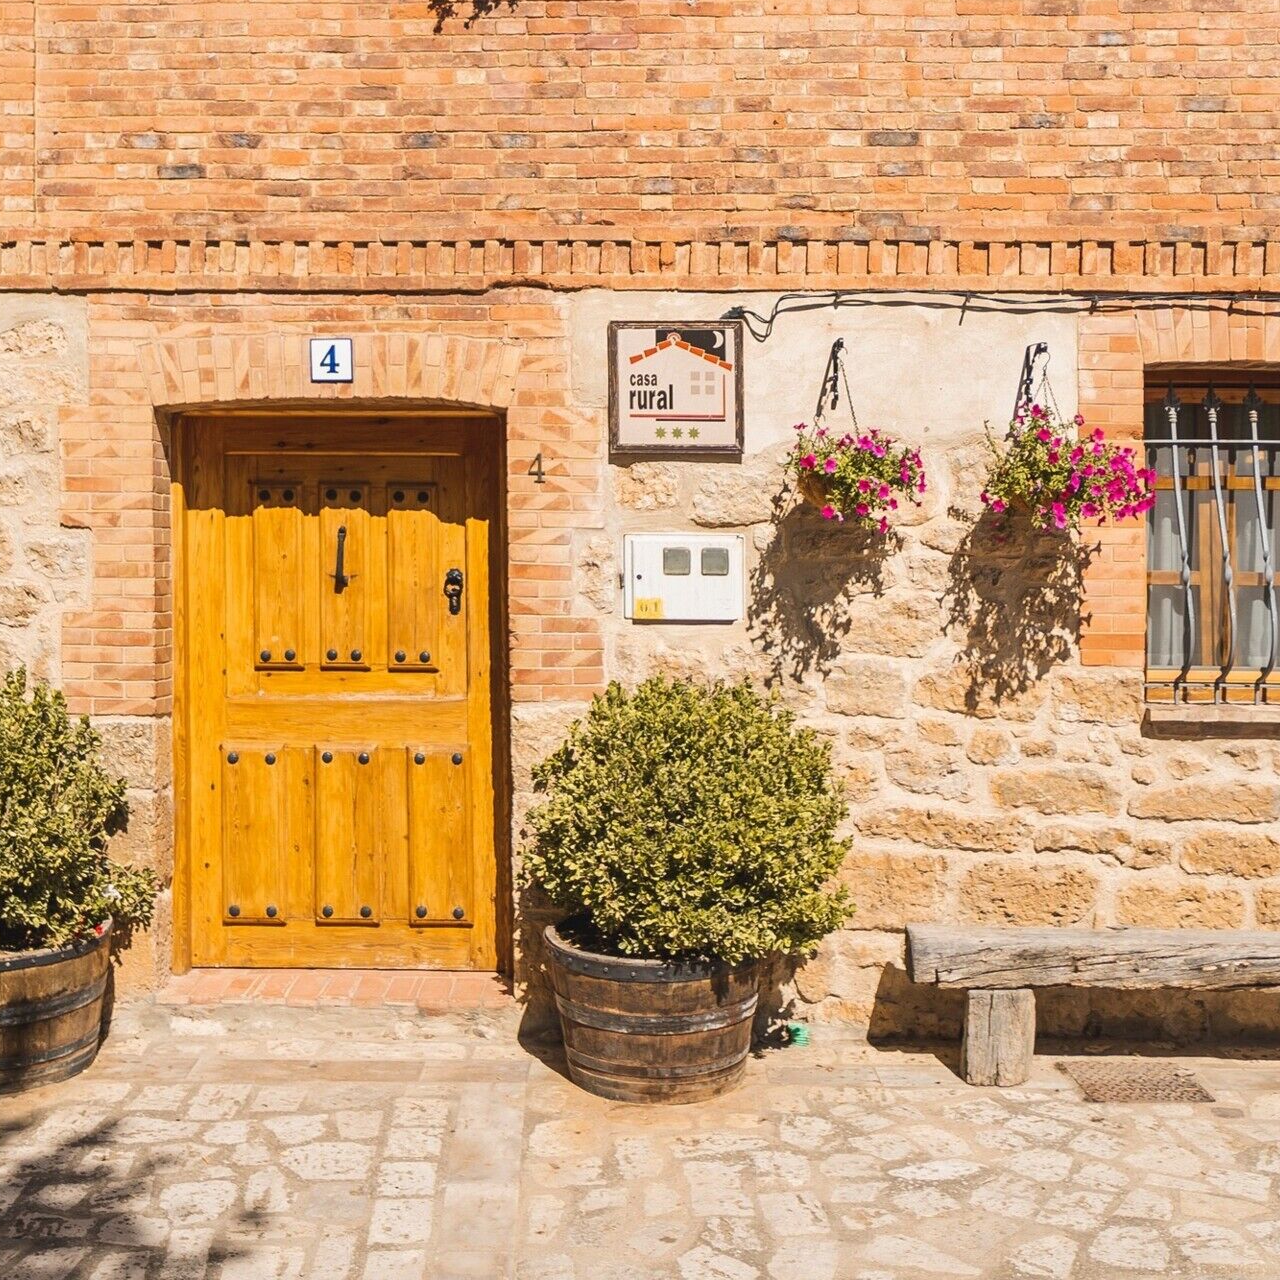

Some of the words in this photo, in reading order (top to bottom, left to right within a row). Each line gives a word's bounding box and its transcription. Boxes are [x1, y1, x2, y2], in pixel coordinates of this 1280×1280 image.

[320, 344, 340, 373] 4
[629, 373, 658, 386] casa
[629, 384, 674, 410] rural
[528, 453, 546, 483] 4
